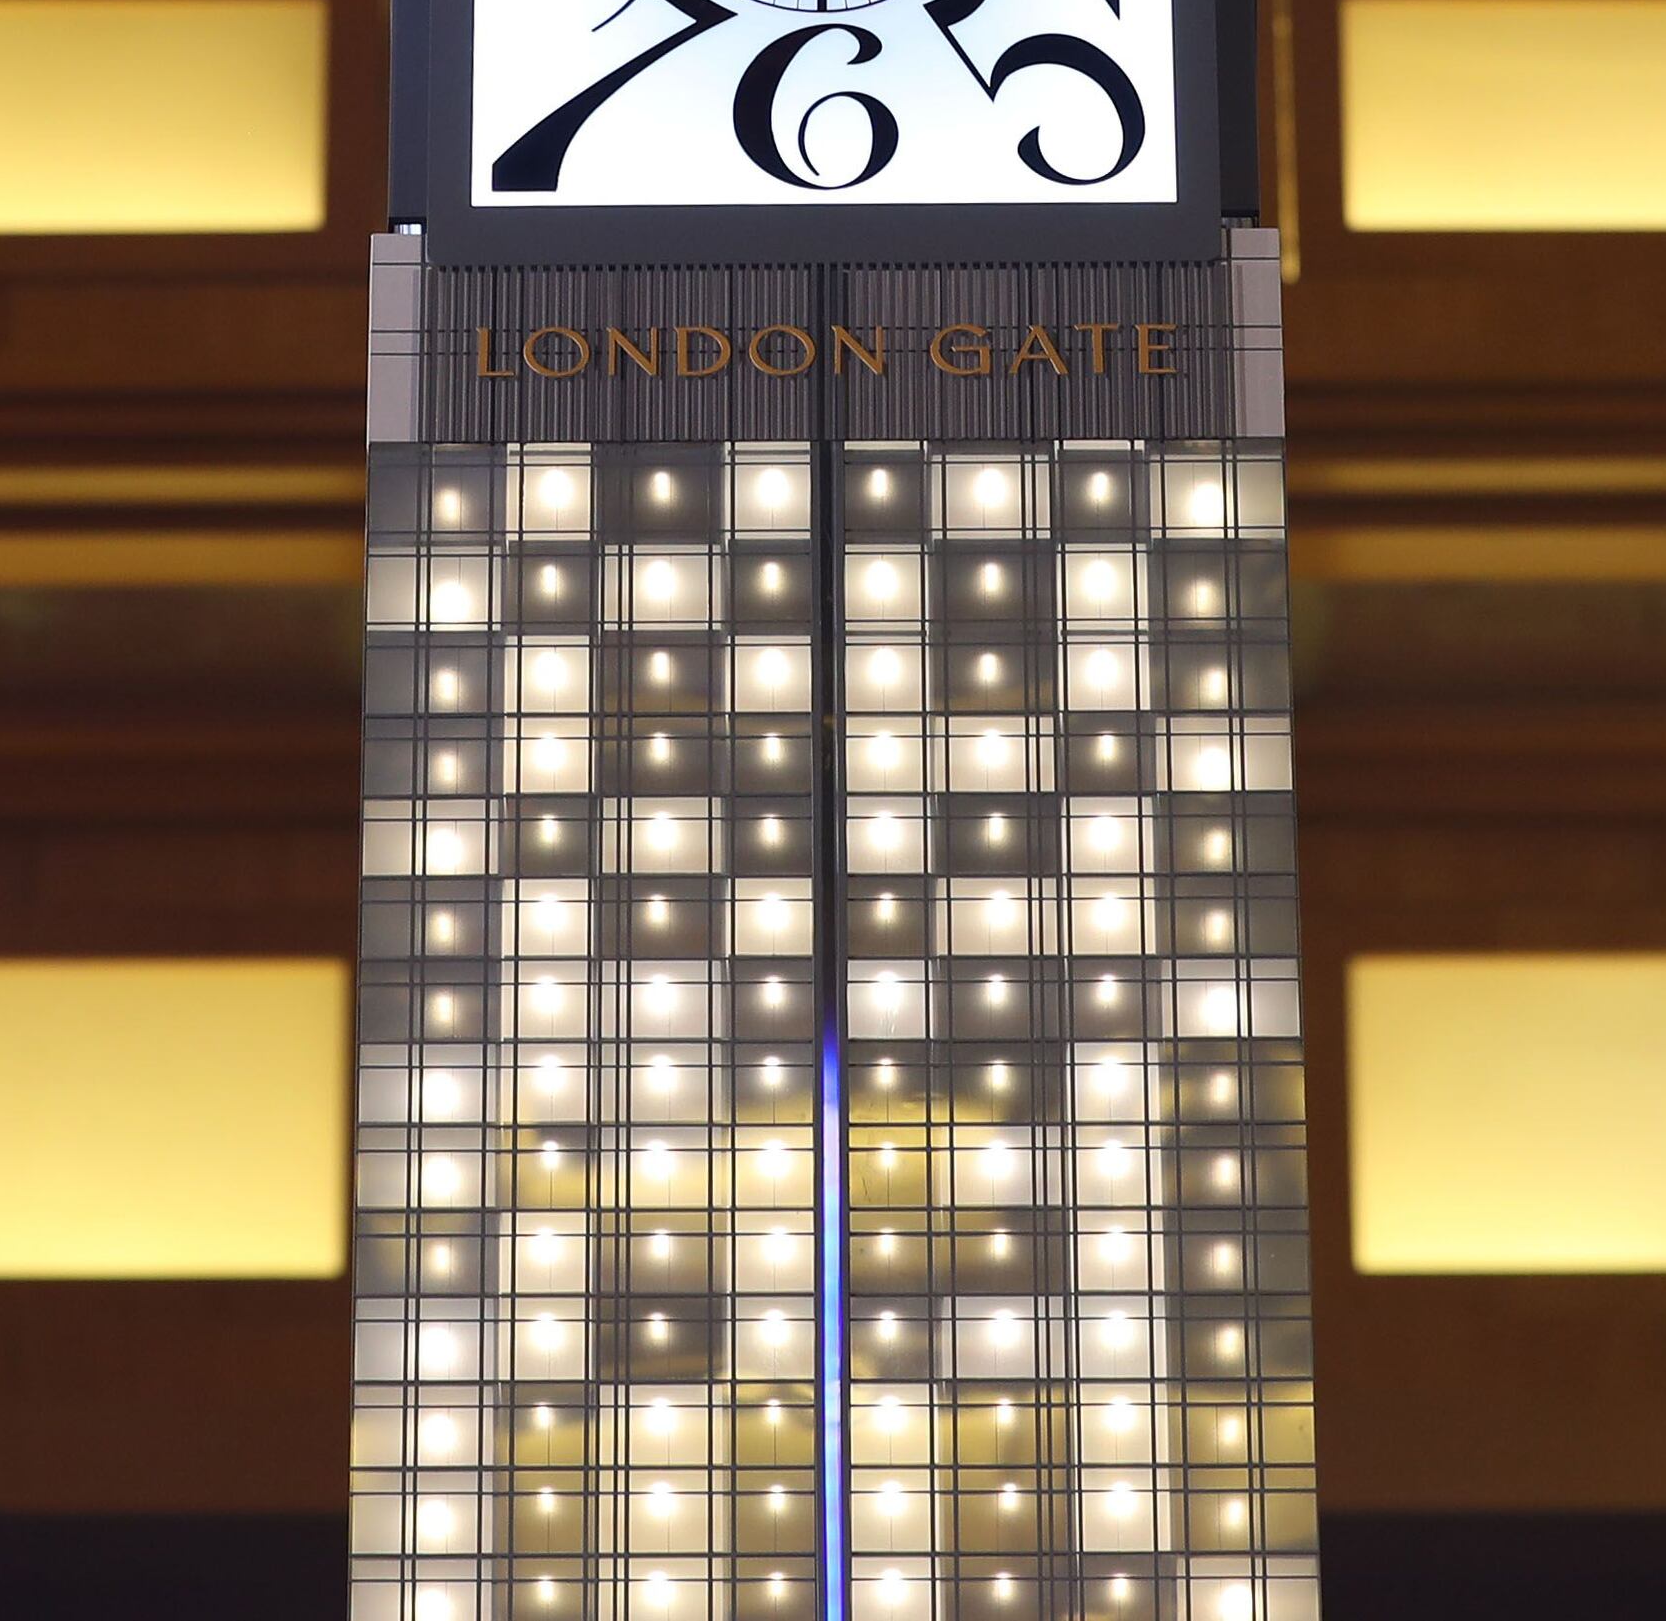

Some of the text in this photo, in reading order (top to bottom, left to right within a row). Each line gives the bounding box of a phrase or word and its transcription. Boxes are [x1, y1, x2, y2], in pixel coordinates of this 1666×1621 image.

[732, 23, 899, 191] 6
[478, 323, 1178, 378] LONDON GATE
